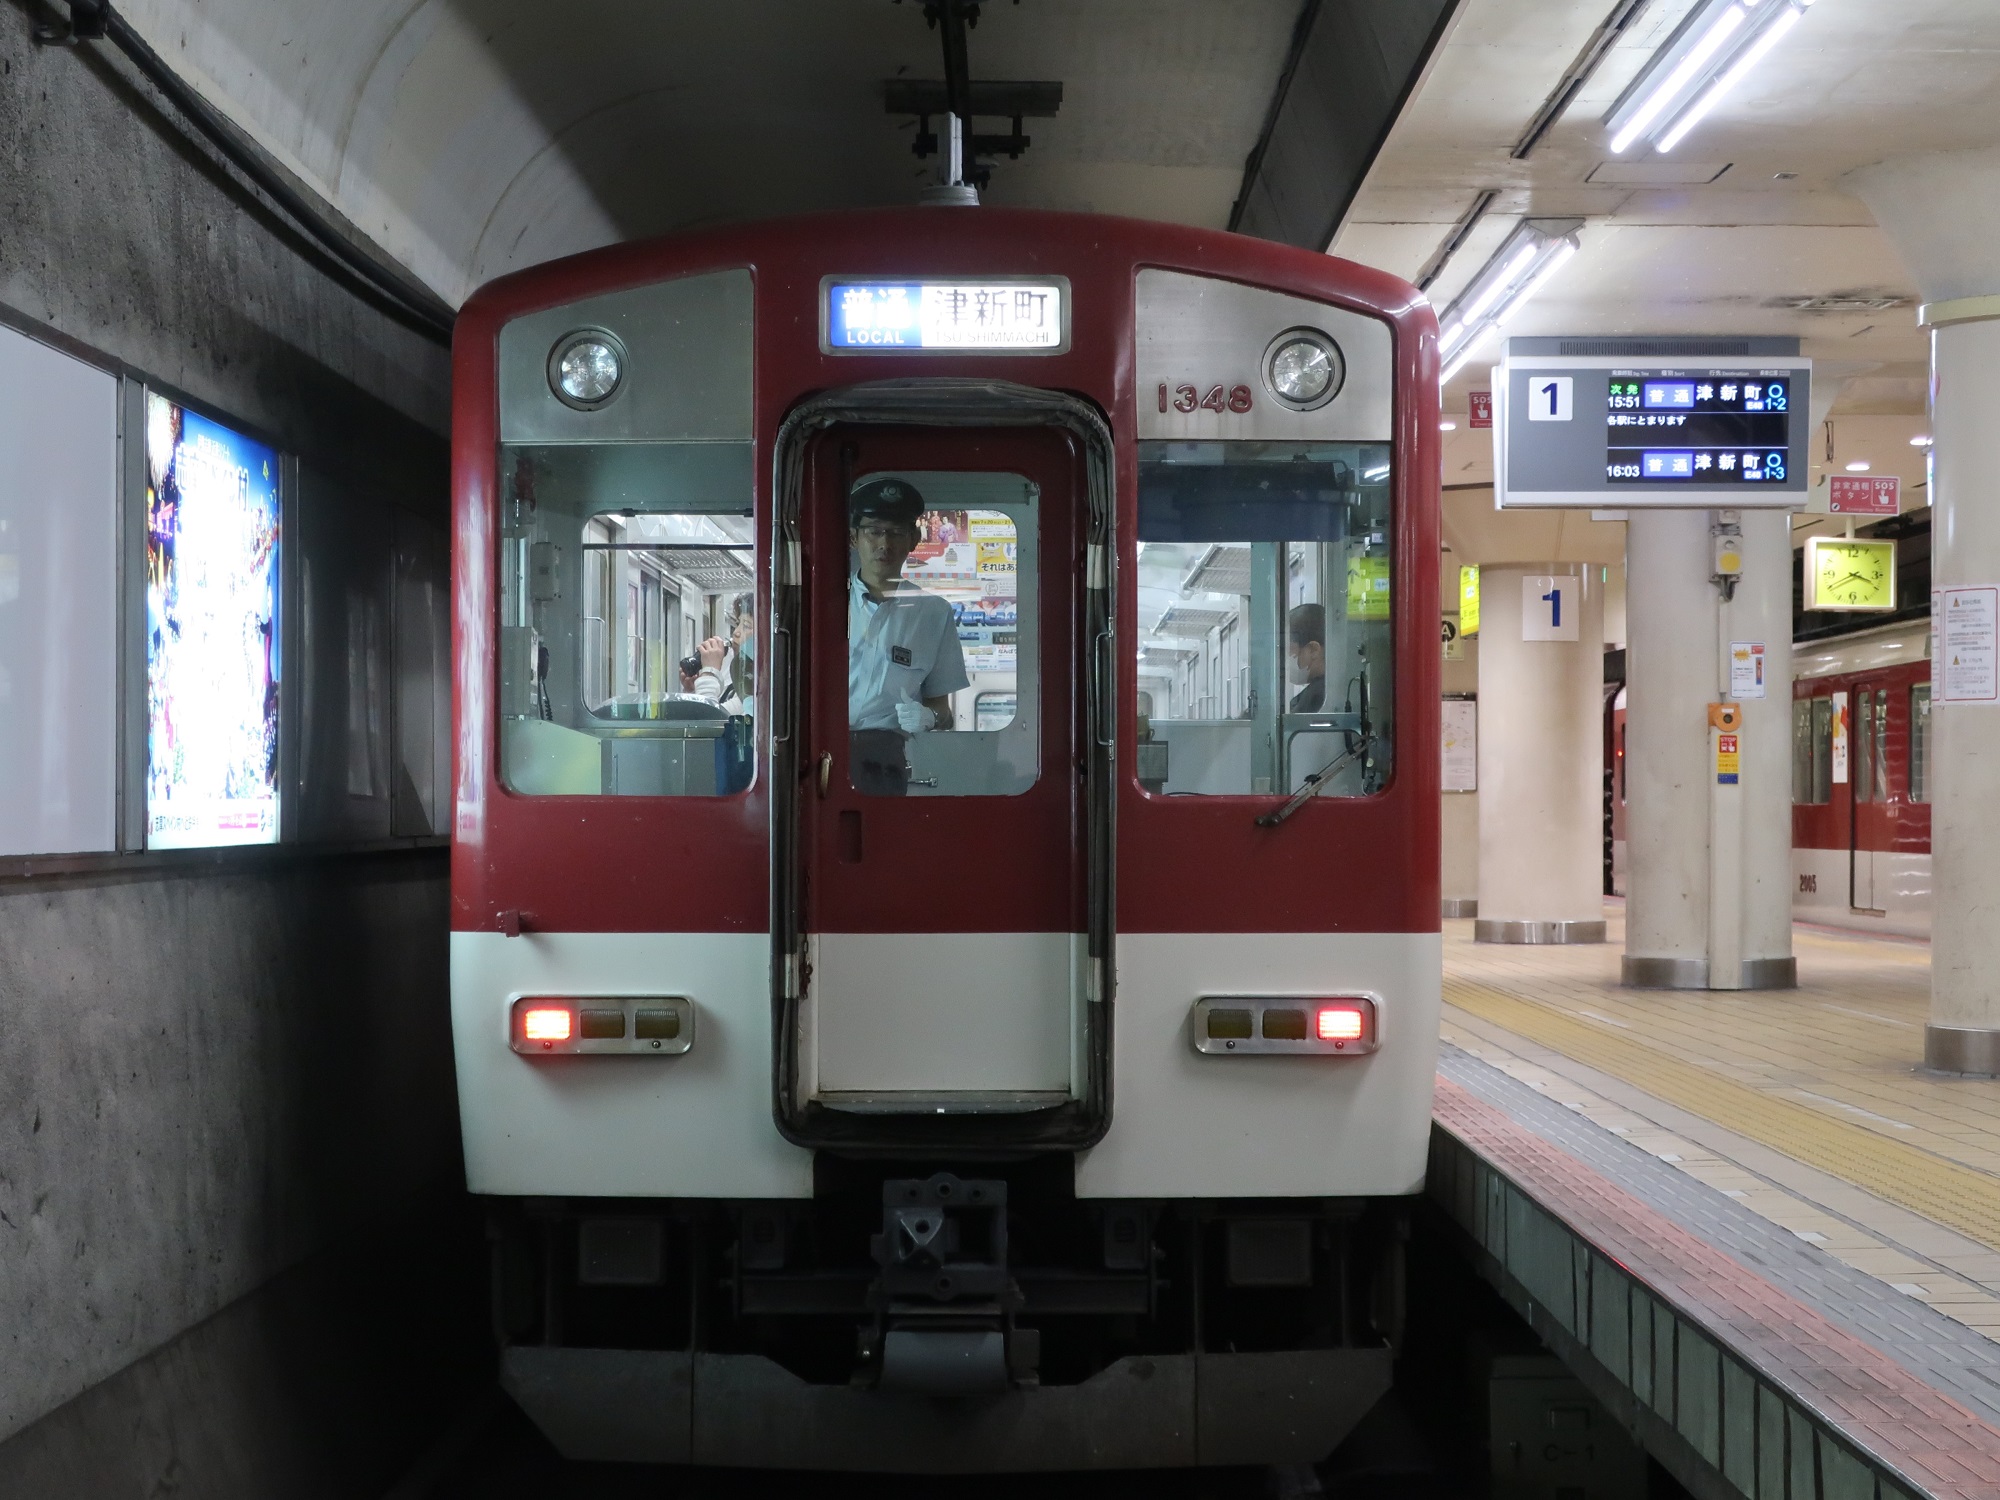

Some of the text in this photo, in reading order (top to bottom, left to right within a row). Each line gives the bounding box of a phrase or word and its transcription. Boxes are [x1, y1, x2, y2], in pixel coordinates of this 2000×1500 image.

[842, 288, 1048, 330] 普通 津新町
[846, 330, 1049, 344] LOCAL TSU SHIMMACHI
[1610, 384, 1639, 396] 次発
[1649, 384, 1762, 403] 普通 津新町
[1158, 383, 1254, 414] 1348
[1541, 382, 1558, 416] 1
[1608, 396, 1640, 409] 15:51
[1607, 415, 1687, 426] 各駅にとまります
[1648, 453, 1761, 473] 普通 津新町
[1606, 465, 1641, 478] 16:03
[1833, 481, 1870, 491] 非常通報
[1874, 481, 1895, 490] SOS
[1832, 491, 1869, 500] ボタン
[1847, 548, 1859, 558] 12
[1827, 570, 1879, 579] 9 3
[1848, 592, 1857, 601] 6
[1542, 589, 1561, 627] 1
[1441, 624, 1452, 638] A
[1543, 1443, 1594, 1462] C-1
